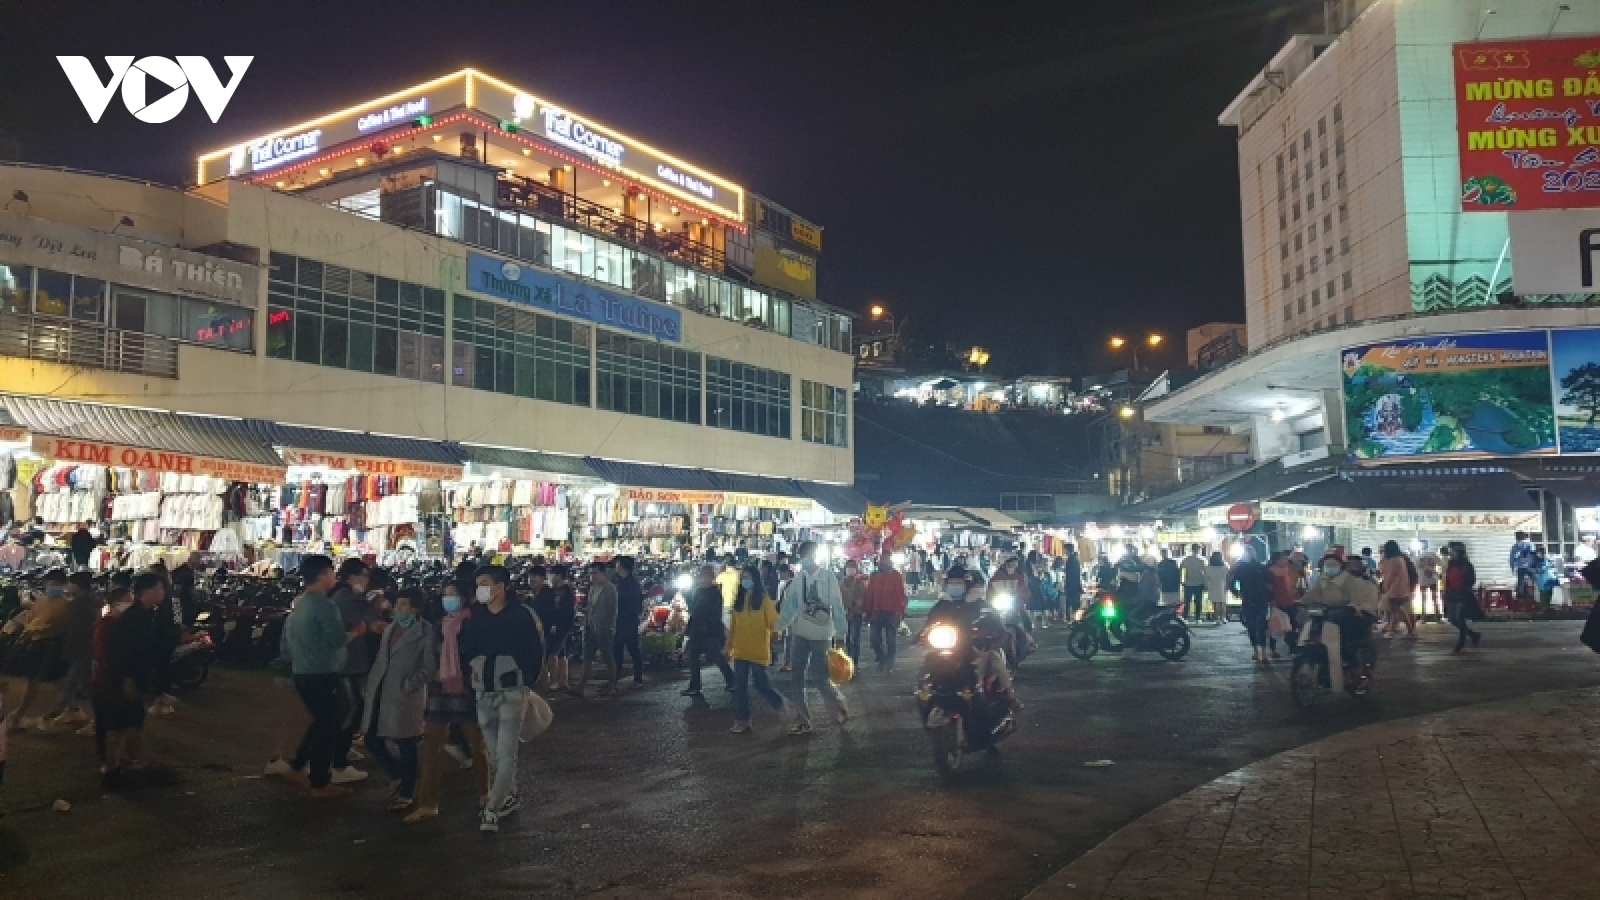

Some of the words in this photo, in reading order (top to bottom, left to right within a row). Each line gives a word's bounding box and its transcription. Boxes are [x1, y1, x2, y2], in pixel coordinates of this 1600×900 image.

[1465, 77, 1555, 101] MỪNG
[574, 121, 625, 160] Corner
[1467, 126, 1557, 151] MỪNG
[599, 293, 679, 337] Tulipe
[54, 439, 111, 464] KIM
[121, 448, 194, 473] OANH
[301, 453, 346, 469] KIM
